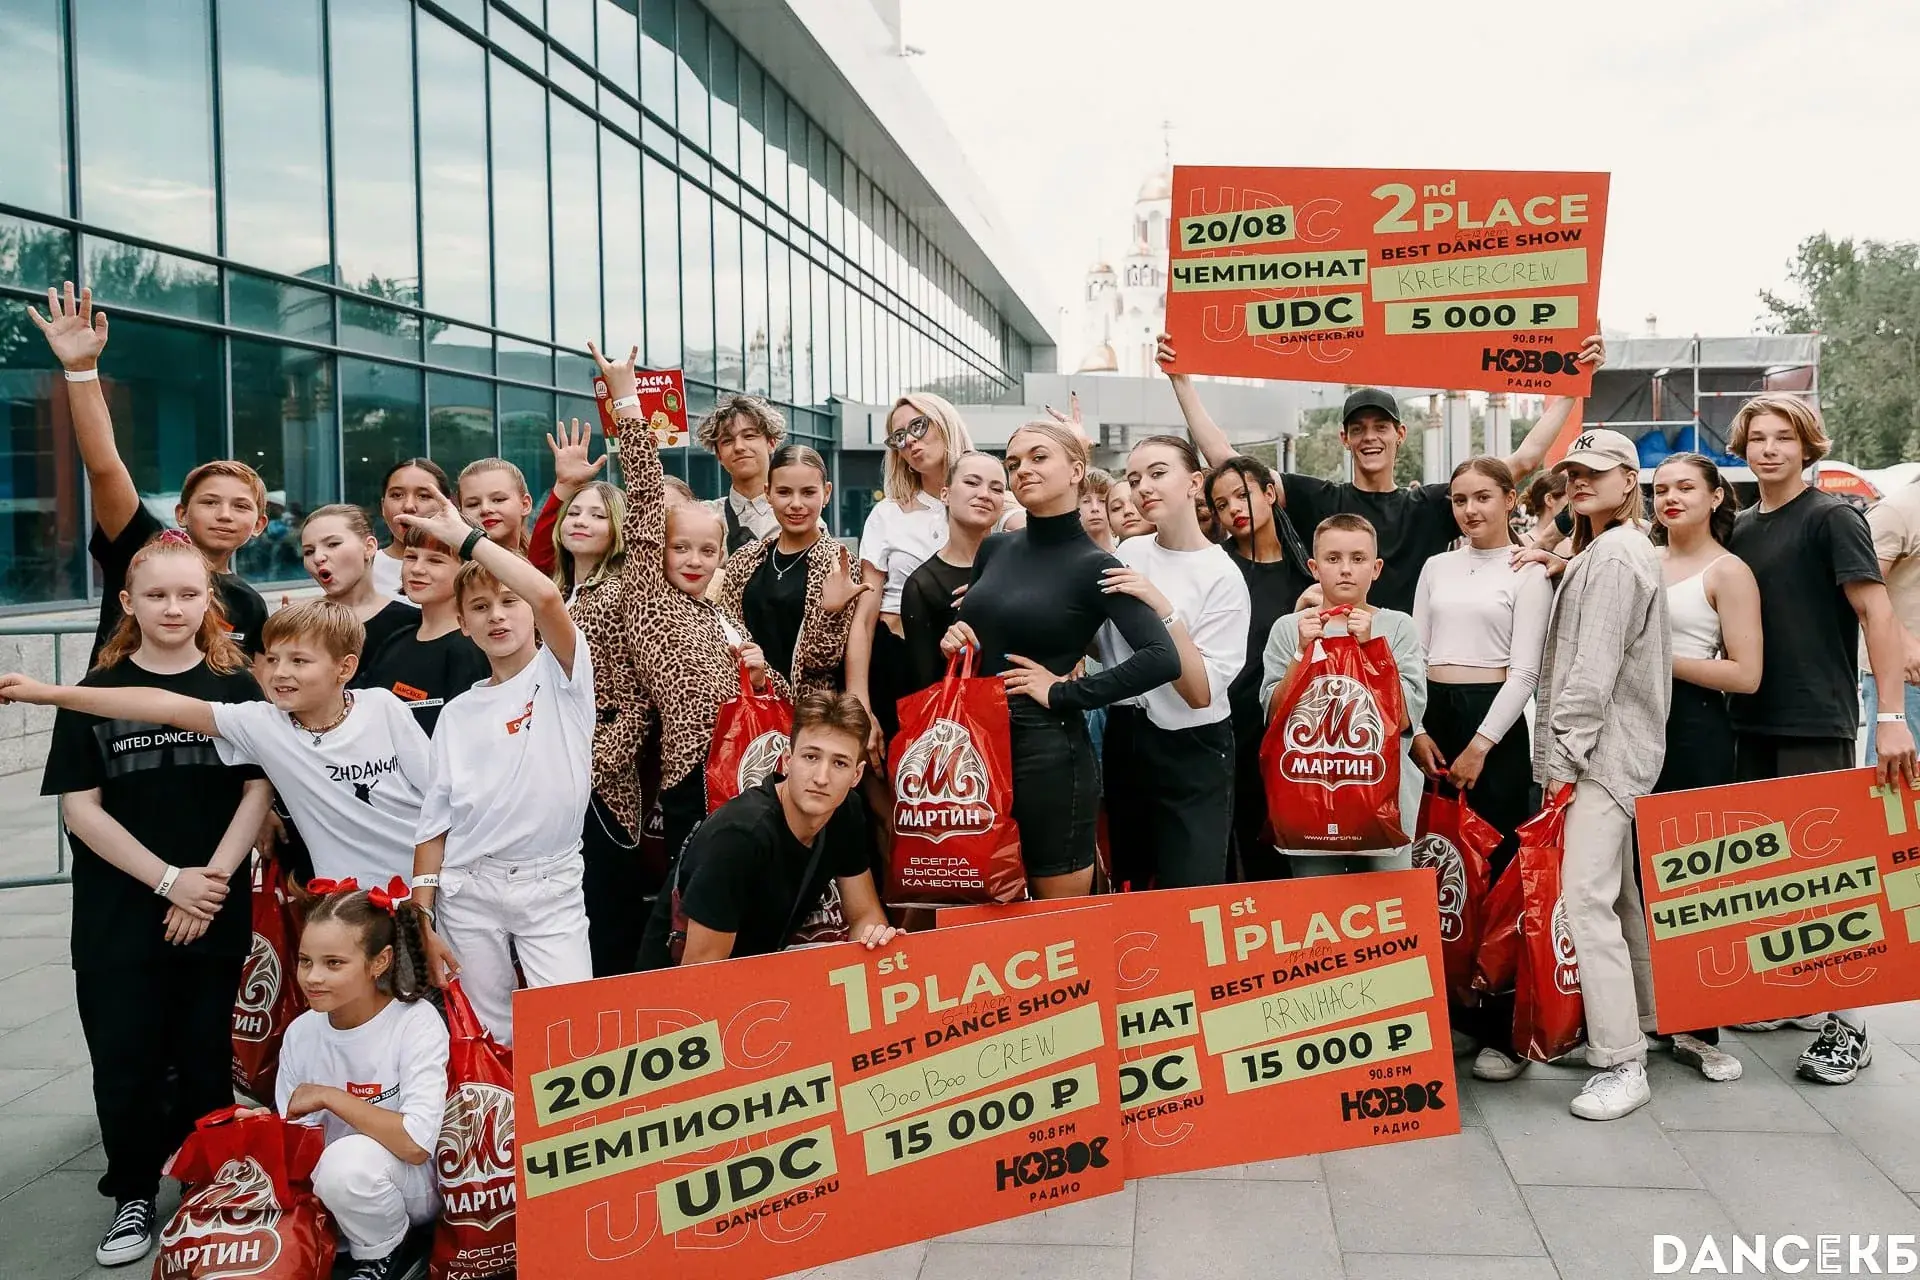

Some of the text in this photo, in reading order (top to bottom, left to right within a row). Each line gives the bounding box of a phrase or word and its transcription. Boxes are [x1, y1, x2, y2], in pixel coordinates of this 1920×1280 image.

[1423, 194, 1589, 231] PLACE
[1186, 213, 1287, 245] 20/08
[1381, 229, 1582, 261] BEST DANCE SHOW
[1173, 258, 1366, 284] ЧЕМПИОНАТ
[1257, 297, 1353, 330] UDC
[1411, 308, 1431, 329] 5
[1444, 304, 1516, 328] 000
[1280, 330, 1365, 344] DANCEKB.RU
[1512, 334, 1554, 344] 90.8 FM
[1507, 378, 1552, 388] РАДИО
[113, 736, 151, 752] UNITED
[154, 731, 194, 746] DANCE
[1291, 758, 1373, 776] МАРТИН
[898, 809, 980, 827] МАРТИН
[903, 868, 980, 877] ВЫСОКОЕ
[910, 857, 970, 866] ВСЕГДА
[1660, 832, 1780, 883] 20/08
[901, 878, 985, 888] КАЧЕСТВО!
[1653, 865, 1876, 929] ЧЕМПИОНАТ
[1234, 898, 1407, 961] PLACE
[1759, 911, 1872, 963] UDC
[1210, 935, 1419, 1001] BEST DANCE SHOW
[1791, 944, 1888, 976] DANCEKB.RU
[881, 940, 1079, 1025] PLACE
[851, 980, 1091, 1072] BEST DANCE SHOW
[977, 1026, 1056, 1080] CREW
[1241, 1050, 1283, 1083] 15
[1296, 1032, 1373, 1070] 000
[543, 1036, 712, 1114] 20/08
[1118, 1055, 1189, 1104] DC
[1368, 1065, 1412, 1080] 90.8 FM
[526, 1075, 832, 1180] ЧЕМПИОНАТ
[885, 1120, 933, 1160] 15
[948, 1091, 1034, 1140] 000
[1028, 1123, 1076, 1144] 90.8 FM
[1373, 1120, 1420, 1135] РАДИО
[675, 1137, 822, 1218] UDC
[1029, 1182, 1081, 1203] РАДИО
[443, 1182, 516, 1213] МАРТИ
[715, 1180, 840, 1233] DANCEKB.RU
[456, 1242, 516, 1259] ВСЕГД
